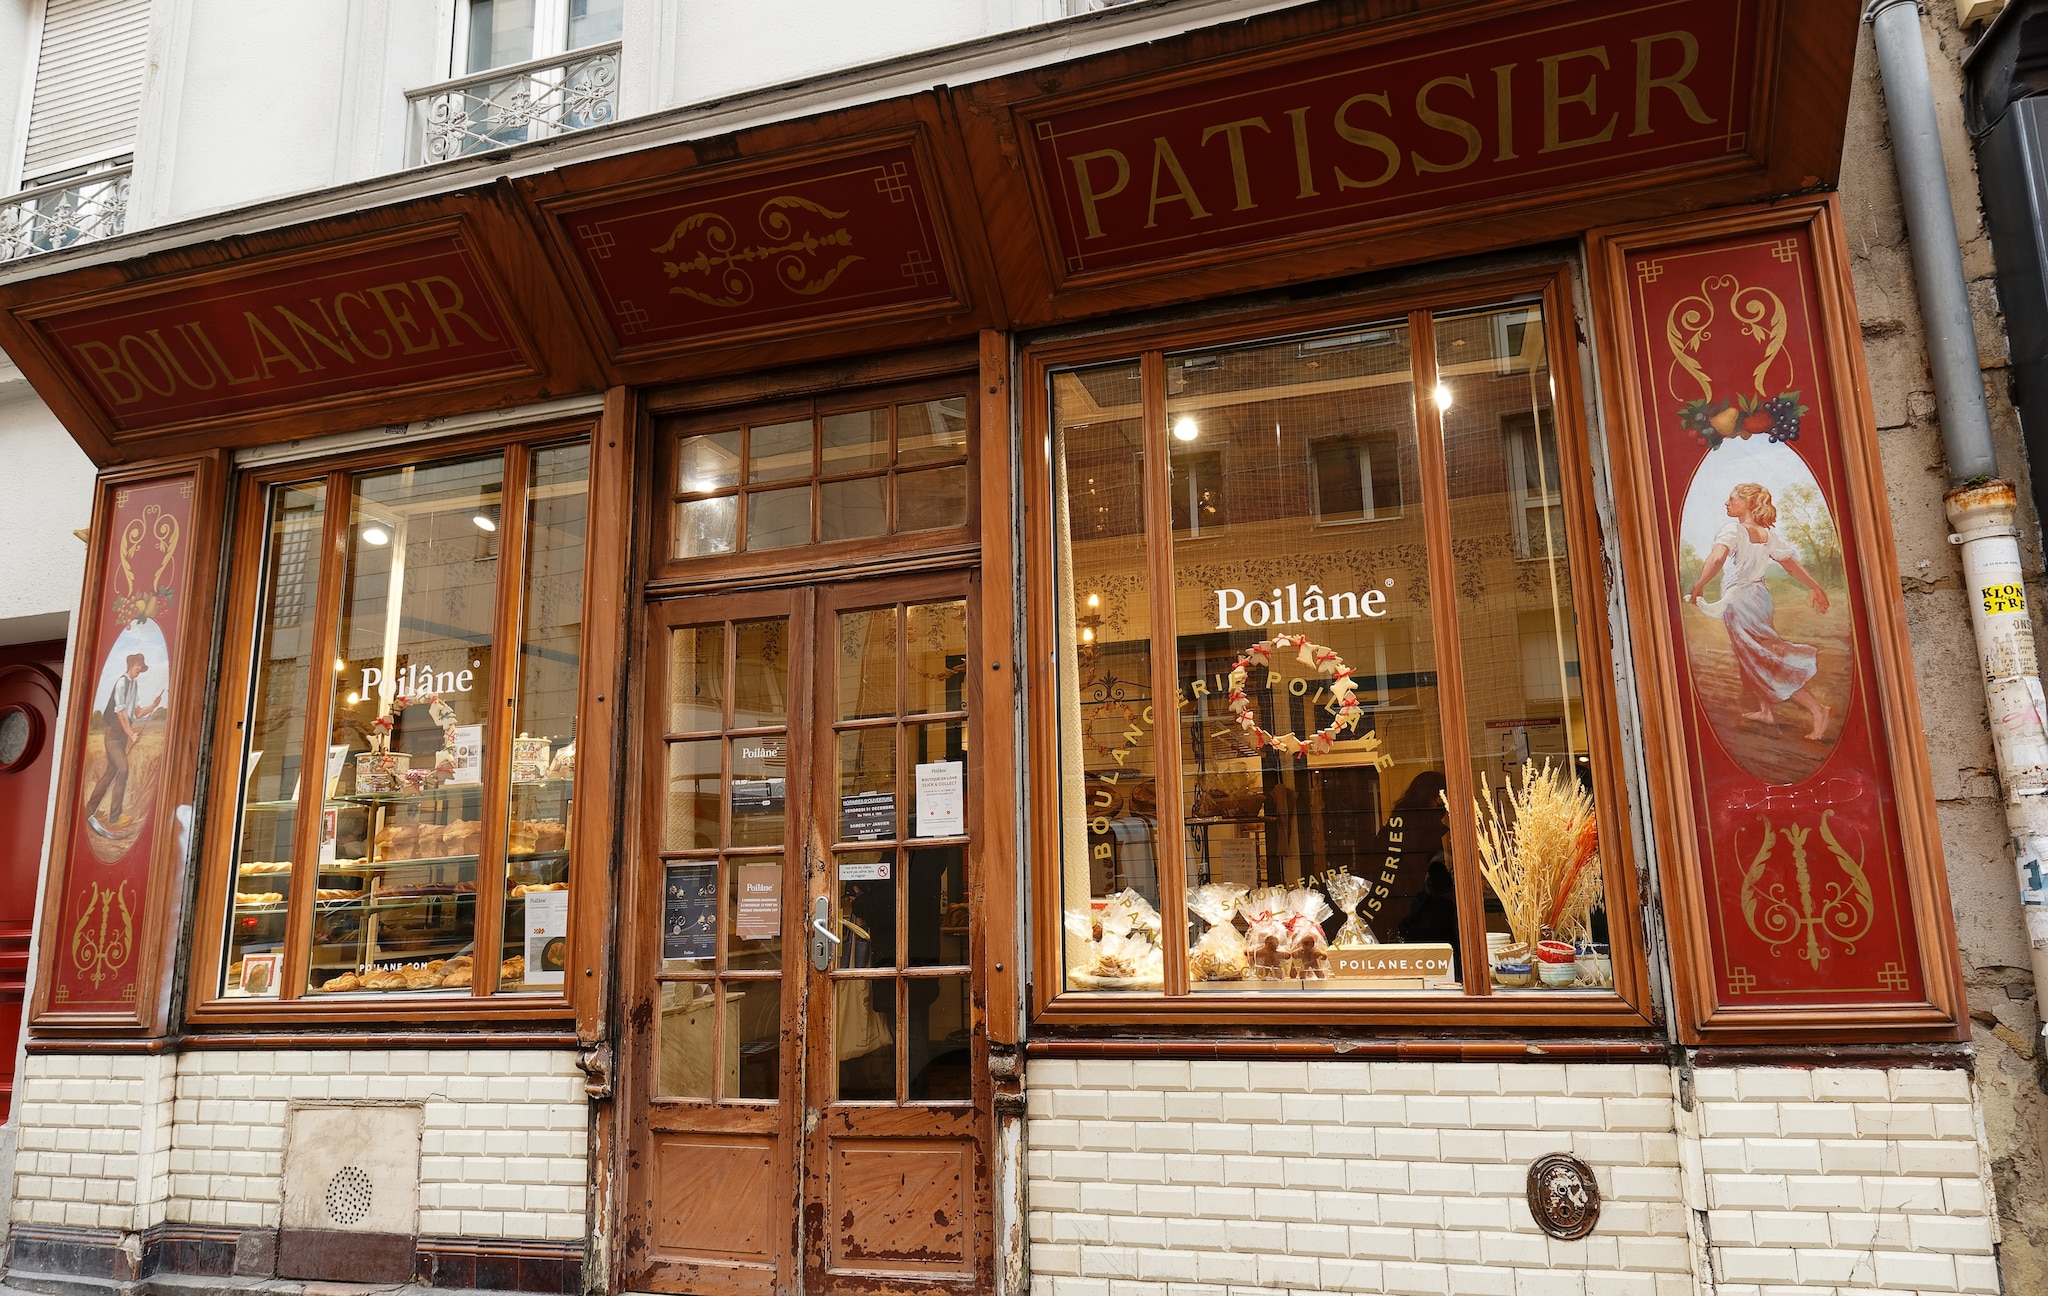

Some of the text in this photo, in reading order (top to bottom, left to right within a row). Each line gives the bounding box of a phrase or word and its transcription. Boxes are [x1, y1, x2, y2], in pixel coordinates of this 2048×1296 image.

[1066, 30, 1718, 241] PATISSIER
[72, 275, 498, 405] BOULANGER
[1221, 864, 1351, 912] SAVOIR-FAIRE
[1331, 816, 1404, 951] PATISSERIES
[1339, 958, 1449, 971] POILANE.COM
